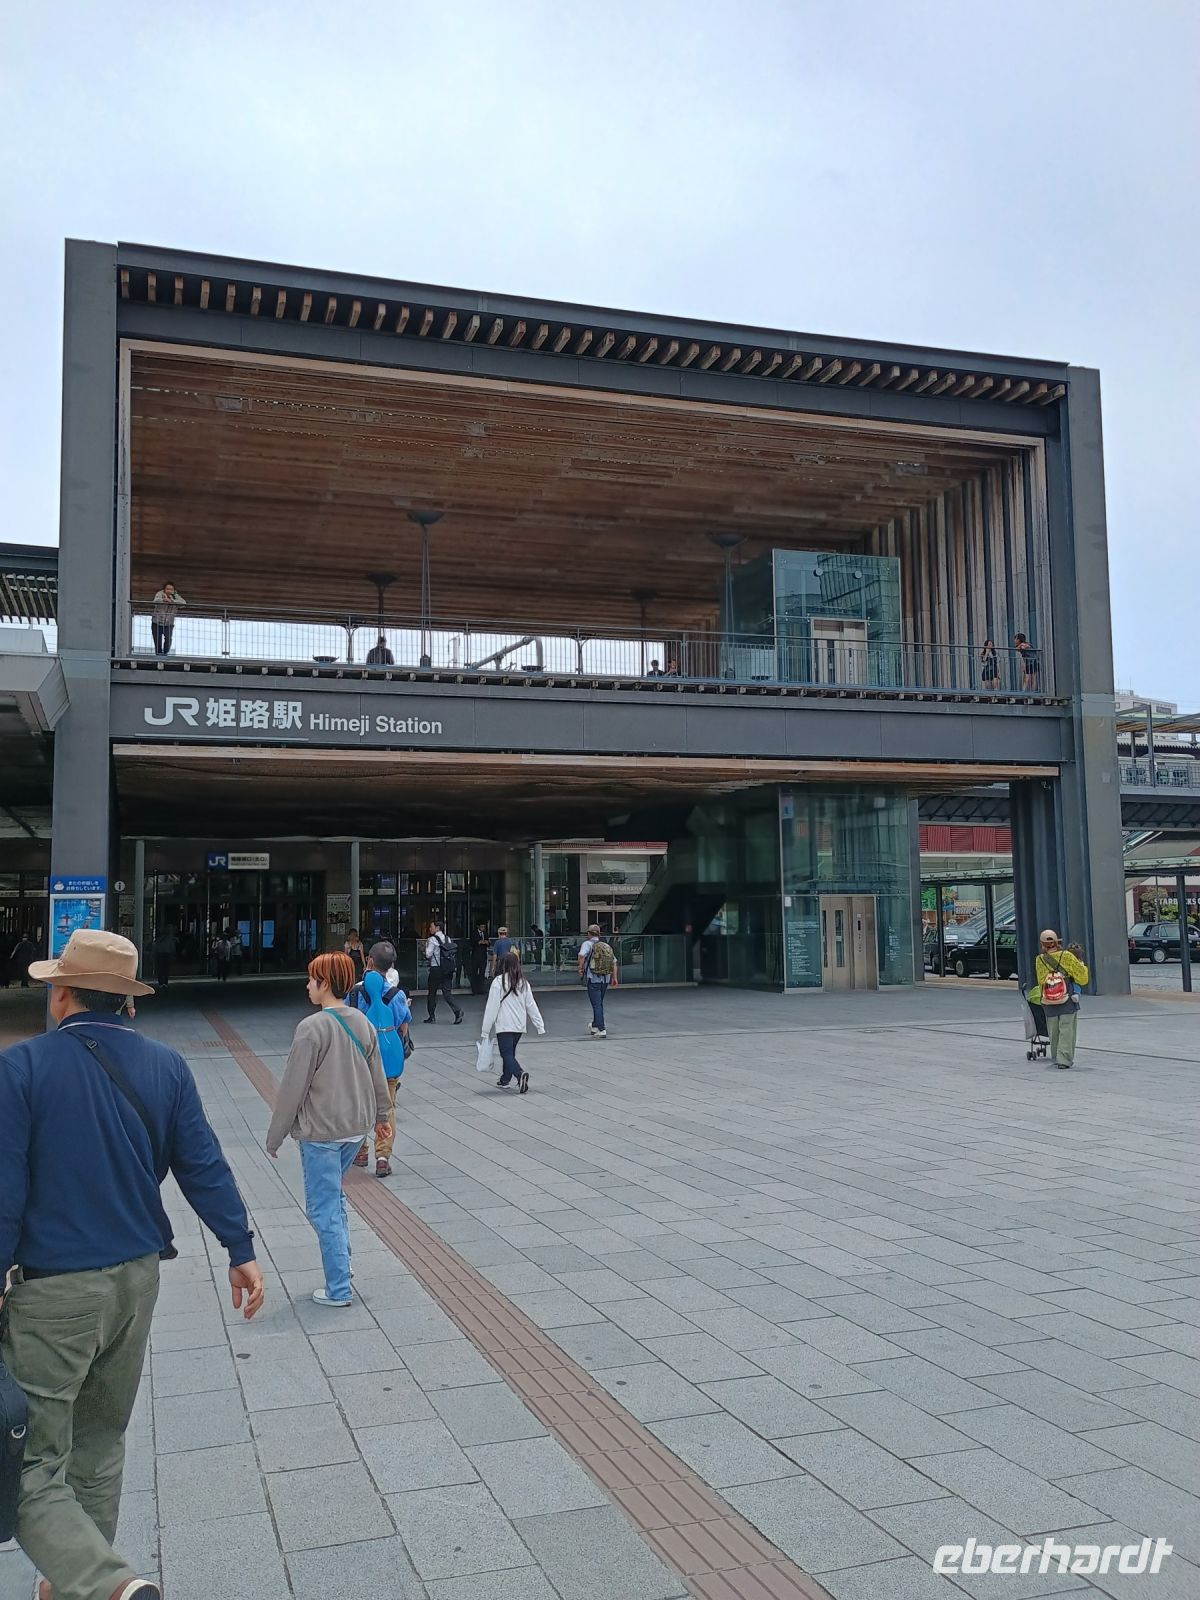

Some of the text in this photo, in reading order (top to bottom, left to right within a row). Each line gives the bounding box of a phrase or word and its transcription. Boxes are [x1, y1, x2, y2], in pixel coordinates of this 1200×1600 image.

[144, 697, 443, 736] JR 姫路駅 Himeji Station
[209, 856, 226, 866] JR
